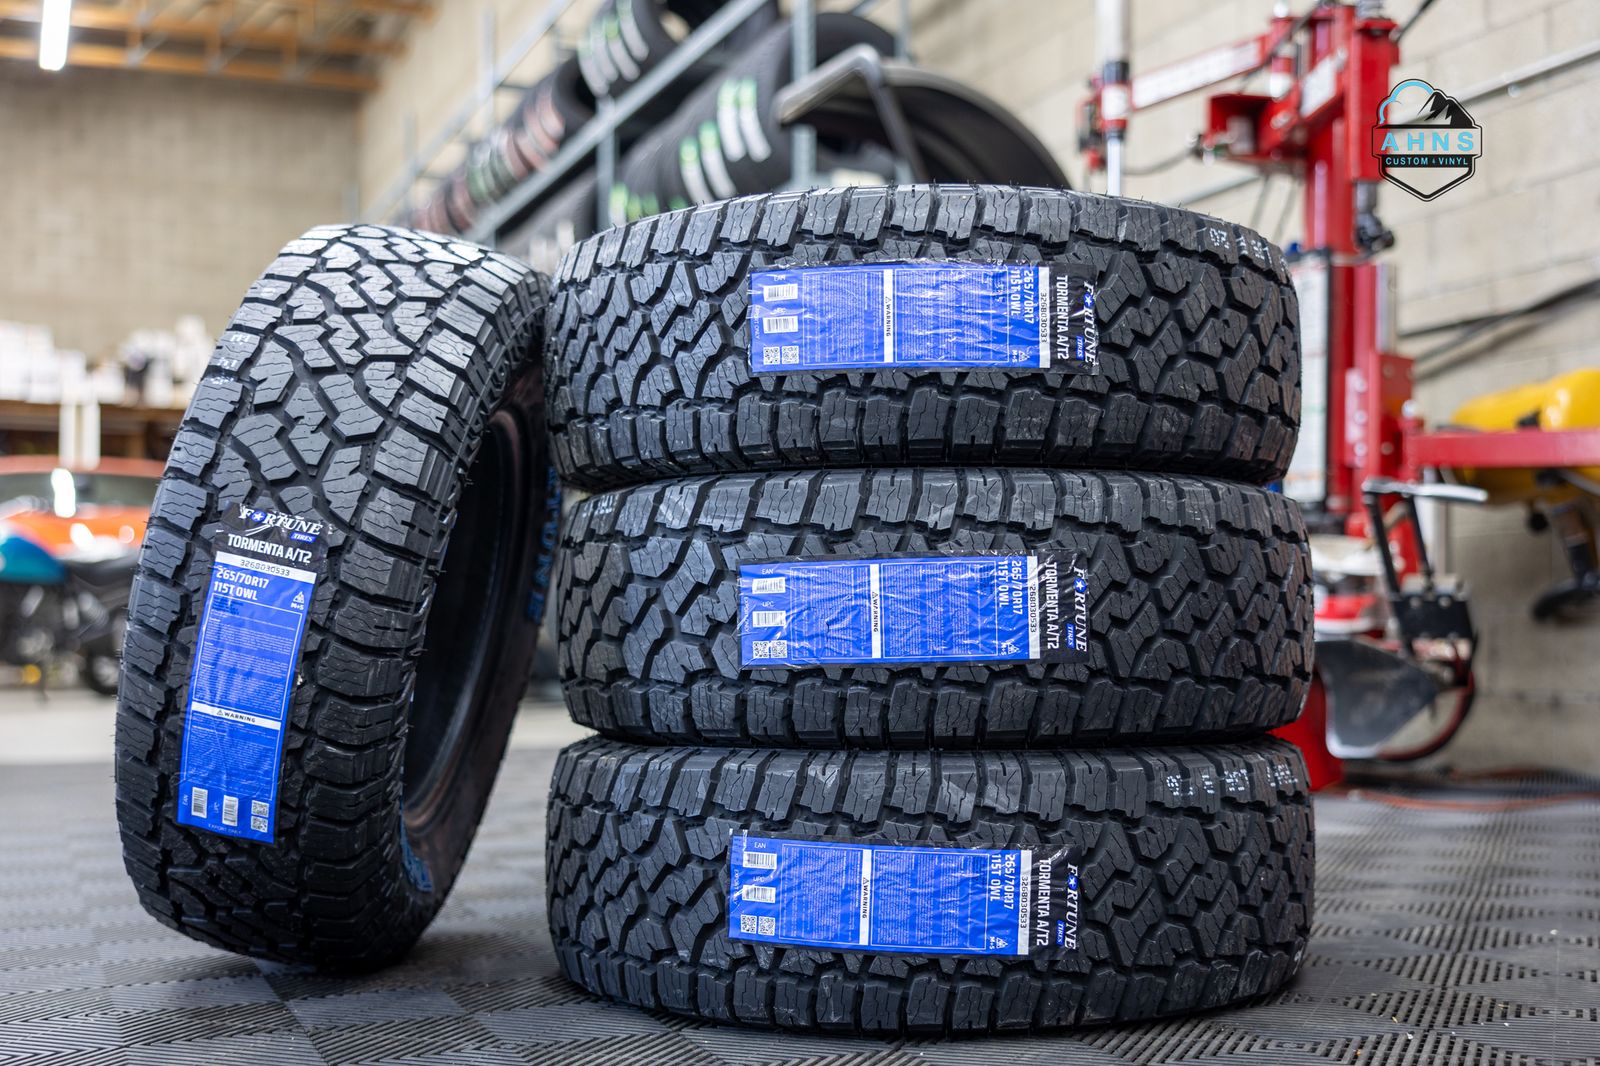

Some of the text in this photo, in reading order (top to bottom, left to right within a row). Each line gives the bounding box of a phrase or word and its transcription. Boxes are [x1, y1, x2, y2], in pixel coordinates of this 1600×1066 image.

[1010, 269, 1021, 316] 115T OWL
[1024, 270, 1035, 324] 265/70R17
[1056, 275, 1070, 360] TORMENTA A/T2
[228, 534, 312, 564] TORMENTA A/T2
[214, 581, 258, 600] 115T OWL
[216, 568, 269, 589] 265/70R17
[998, 560, 1009, 607] 115T OWL
[1012, 560, 1023, 615] 265/70R17
[1029, 583, 1037, 633] 268030533
[1045, 562, 1060, 649] TORMENTA A/T2
[224, 711, 256, 723] WARNING
[990, 854, 1001, 901] 115T OWL
[1003, 854, 1015, 910] 265/70R17
[1020, 876, 1029, 929] 3268030533
[1036, 858, 1051, 946] TORMENTA A/T2
